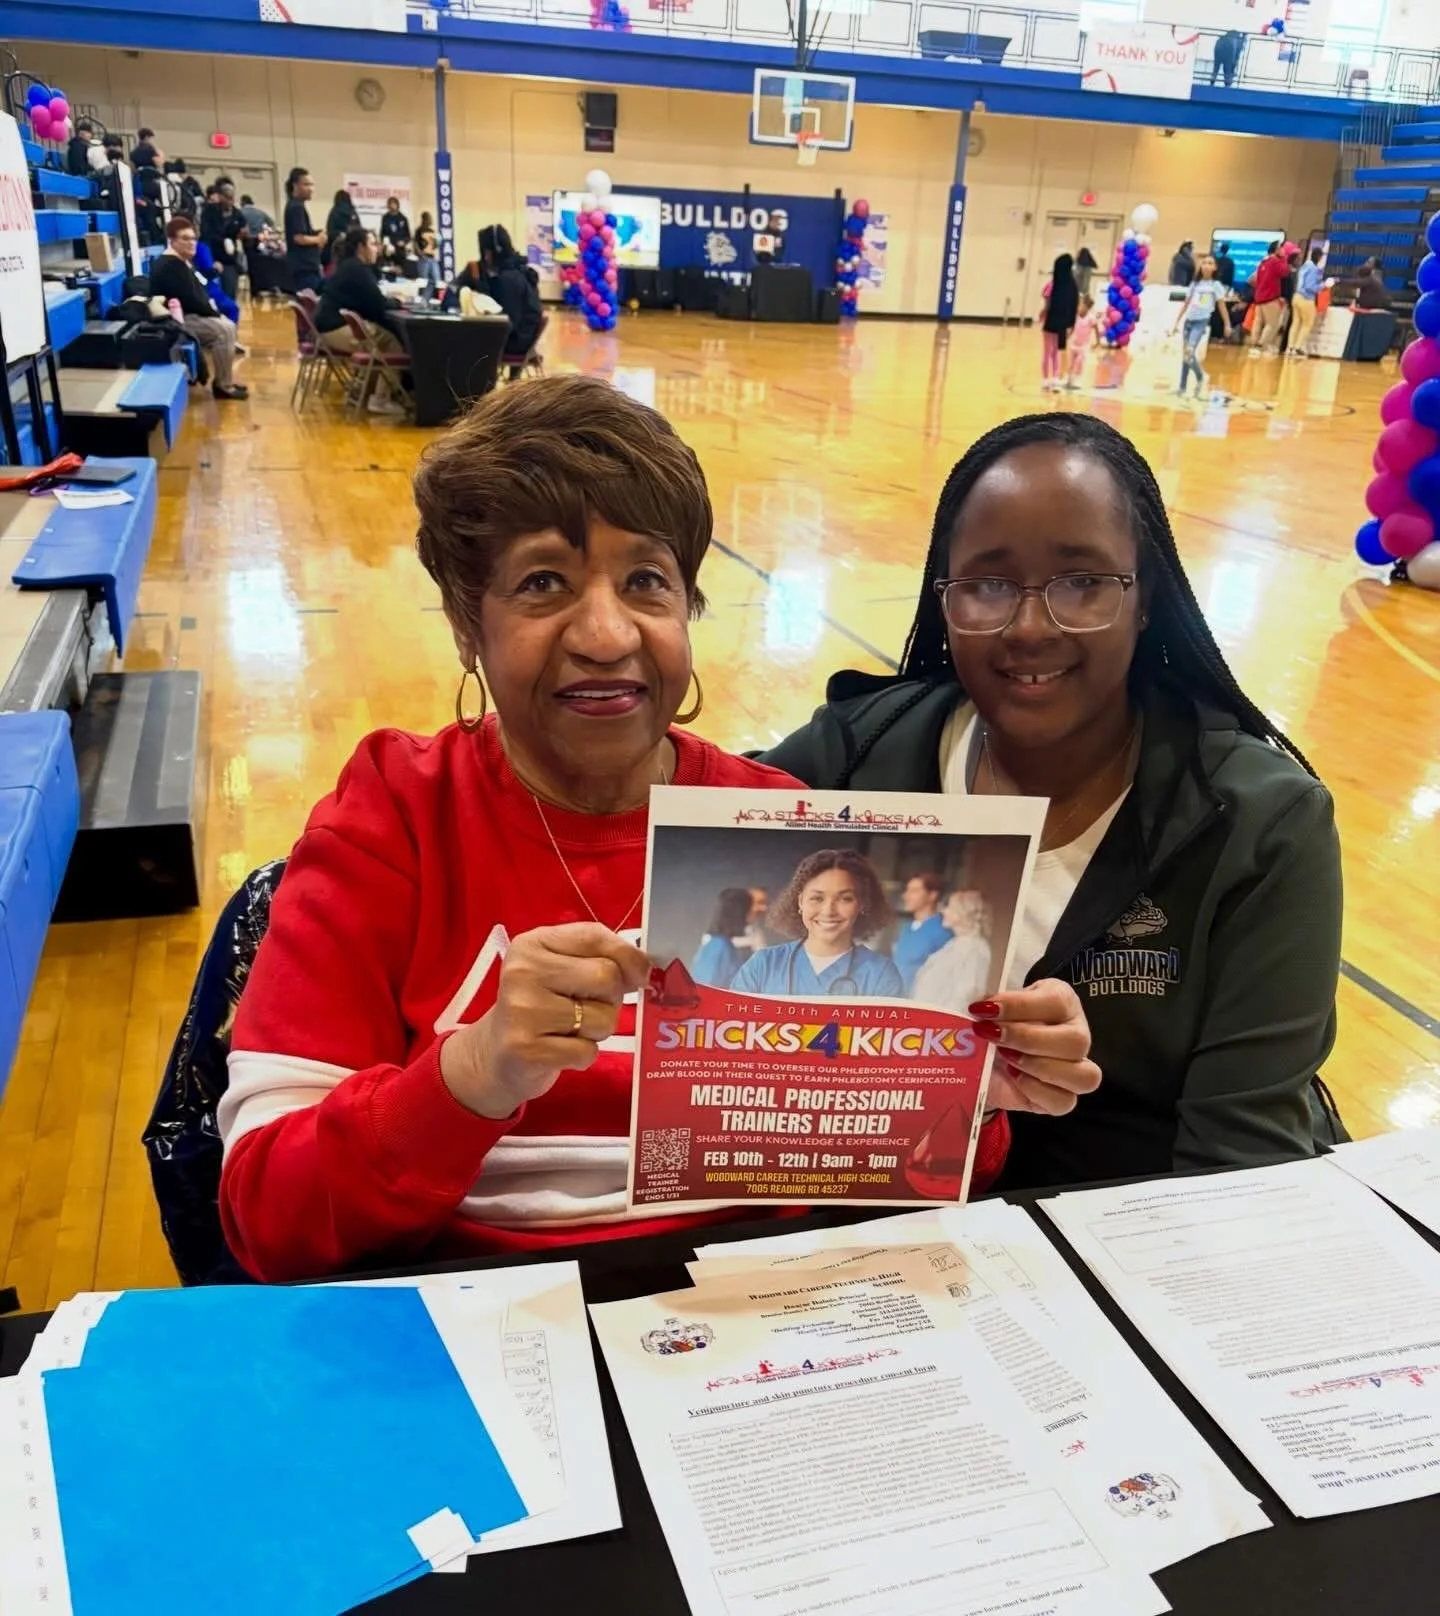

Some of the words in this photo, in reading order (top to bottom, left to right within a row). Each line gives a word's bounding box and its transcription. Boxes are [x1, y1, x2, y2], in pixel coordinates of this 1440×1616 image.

[1097, 42, 1147, 61] THANK
[1155, 50, 1187, 65] YOU
[438, 169, 454, 282] WOODWARD
[945, 200, 963, 303] BULLDOGS
[838, 805, 850, 822] 4
[834, 822, 870, 830] Simulated
[872, 823, 898, 831] Clinical
[1070, 946, 1180, 985] WOODWARD
[1089, 979, 1165, 996] BULLDOGS
[725, 1004, 762, 1013] THE
[776, 1007, 818, 1016] 10th
[832, 1008, 911, 1020] ANNUAL
[655, 1019, 801, 1053] STICKS
[806, 1021, 841, 1058] 4
[851, 1027, 976, 1057] KICKS
[703, 1061, 729, 1069] YOUR
[732, 1062, 754, 1070] TIME
[772, 1064, 815, 1073] OVERSEE
[818, 1066, 838, 1074] OUR
[840, 1067, 903, 1075] PHLEBOTOMY
[906, 1067, 955, 1075] STUDENTS
[647, 1071, 674, 1079] DRAW
[755, 1073, 787, 1081] QUEST
[805, 1075, 830, 1083] EARN
[832, 1076, 896, 1084] PHLEBOTOMY
[690, 1085, 778, 1108] MEDICAL
[784, 1089, 924, 1110] PROFESSIONAL
[720, 1110, 812, 1135] TRAINERS
[818, 1114, 891, 1135] NEEDED
[696, 1135, 731, 1143] SHARE
[734, 1136, 763, 1144] YOUR
[765, 1136, 835, 1146] KNOWLEDGE
[846, 1138, 910, 1146] EXPERIENCE
[704, 1151, 728, 1166] FEB
[733, 1151, 763, 1167] 10th
[778, 1153, 809, 1168] 12th
[821, 1154, 853, 1168] 9am
[868, 1153, 897, 1169] 1pm
[705, 1172, 754, 1182] WOODWARD
[757, 1173, 789, 1183] CAREER
[791, 1173, 836, 1183] TECHNICAL
[838, 1173, 857, 1183] HIGH
[859, 1173, 892, 1183] SCHOOL
[636, 1185, 689, 1195] REGISTRATION
[747, 1184, 768, 1194] 7005
[770, 1184, 806, 1194] READING
[808, 1184, 819, 1194] RD
[821, 1184, 849, 1194] 45237
[802, 1358, 814, 1370] 4
[752, 1394, 770, 1405] and
[772, 1390, 791, 1401] skin
[792, 1383, 832, 1397] puncture
[835, 1374, 879, 1390] procedure
[914, 1363, 937, 1375] form
